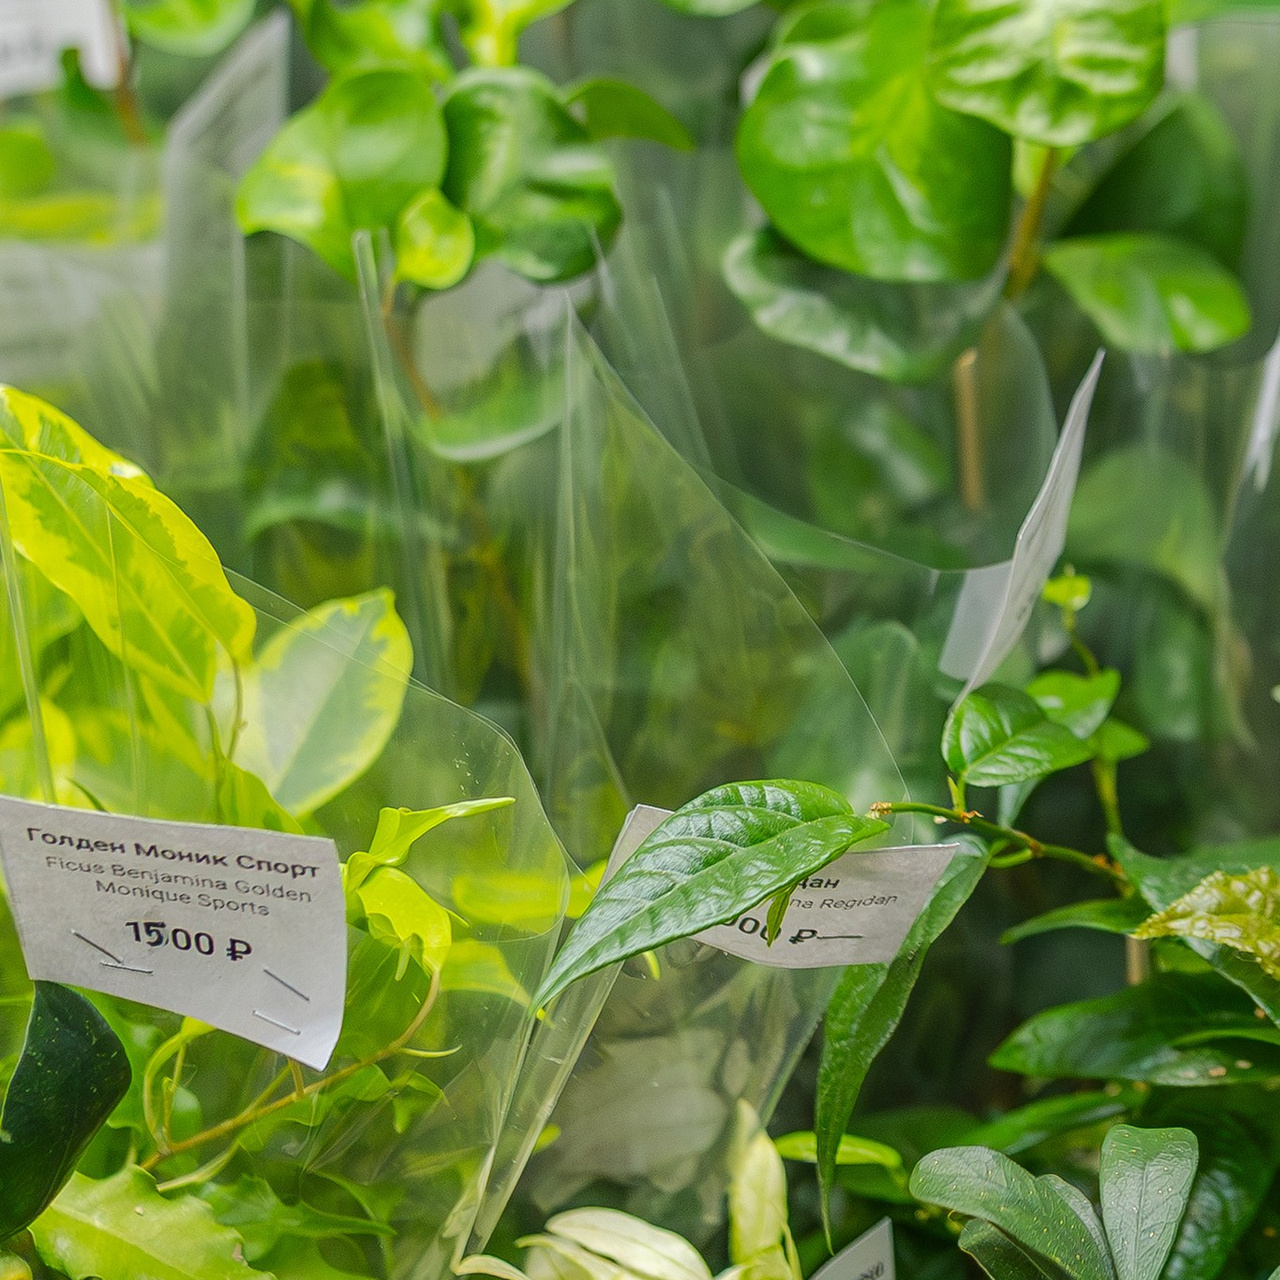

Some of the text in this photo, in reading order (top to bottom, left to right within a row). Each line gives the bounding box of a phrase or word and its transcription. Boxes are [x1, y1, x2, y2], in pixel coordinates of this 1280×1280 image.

[27, 827, 320, 879] Голден Моник Спорт
[46, 856, 312, 903] Ficus Benjamina Golden
[95, 880, 270, 916] Monique Sports
[125, 921, 214, 955] 1500
